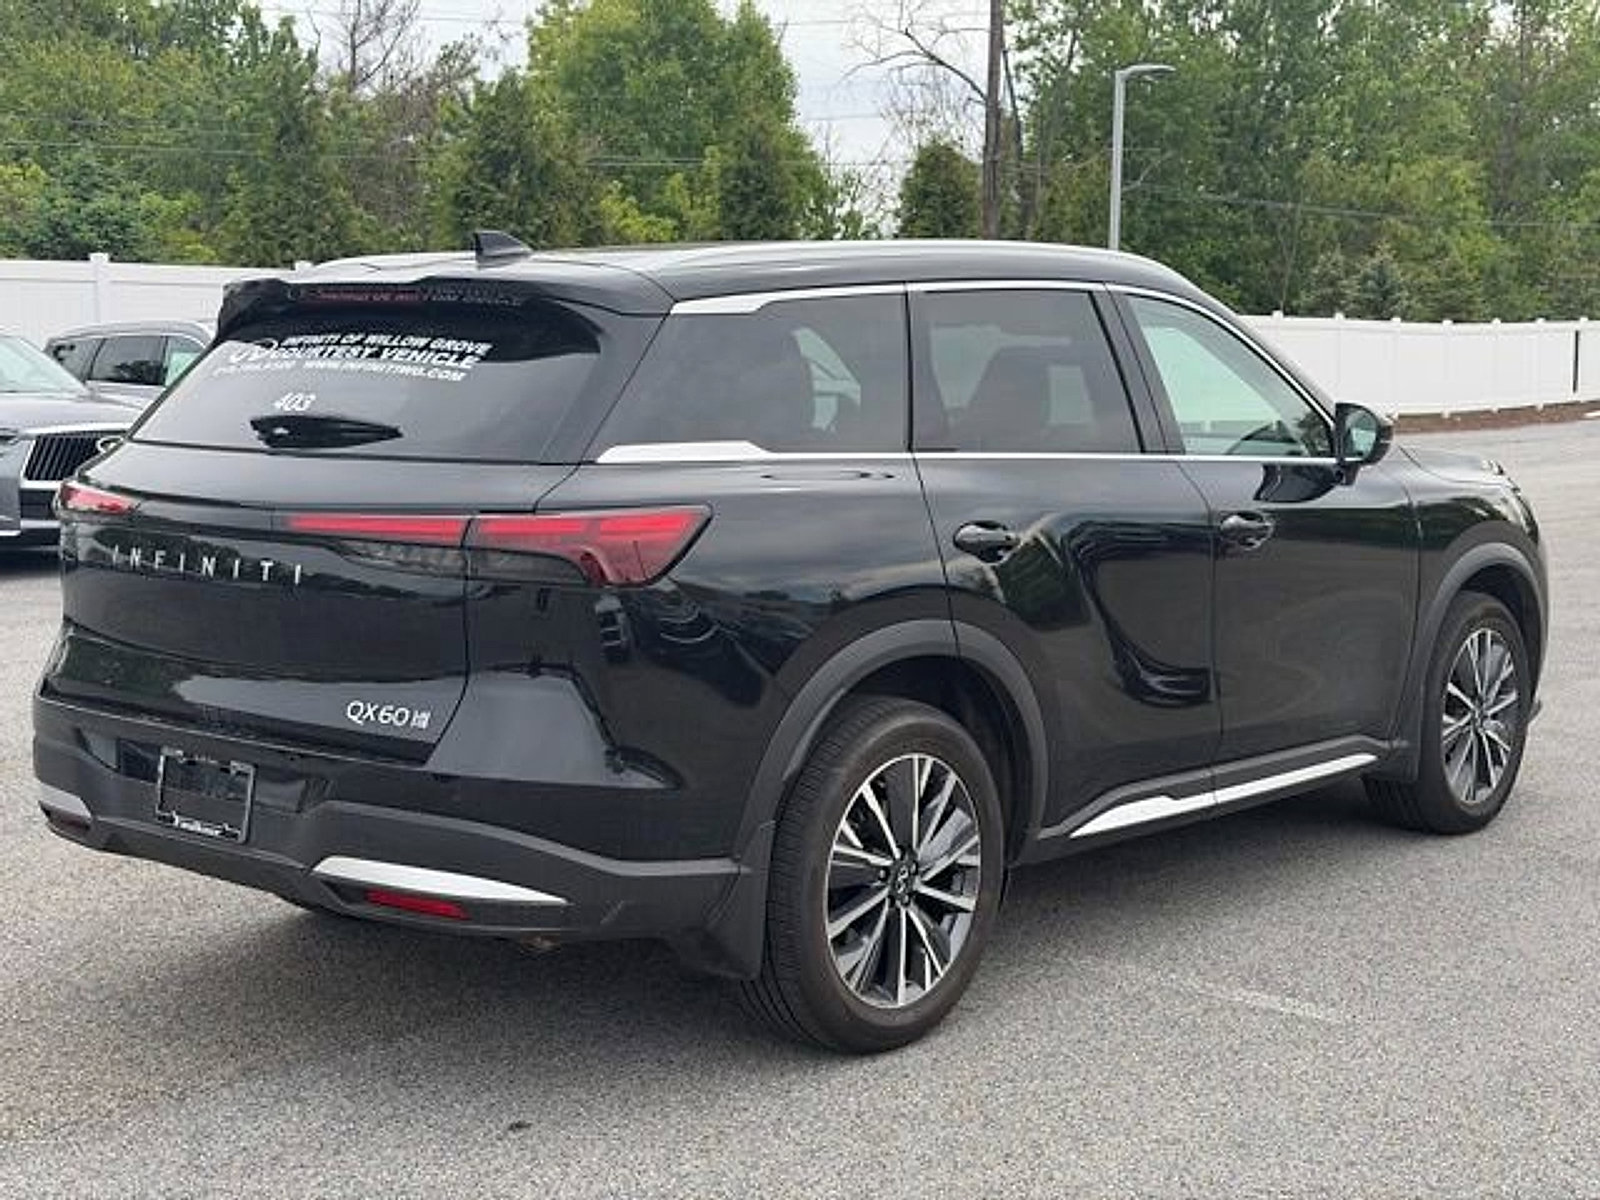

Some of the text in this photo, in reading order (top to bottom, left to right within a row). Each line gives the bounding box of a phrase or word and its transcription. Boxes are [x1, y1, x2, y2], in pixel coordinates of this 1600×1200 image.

[341, 332, 366, 344] OF
[365, 334, 431, 348] WILLOW
[430, 337, 493, 355] GROVE
[380, 347, 481, 369] VEHICLE
[112, 544, 301, 584] INFINITI
[347, 701, 409, 726] QX60
